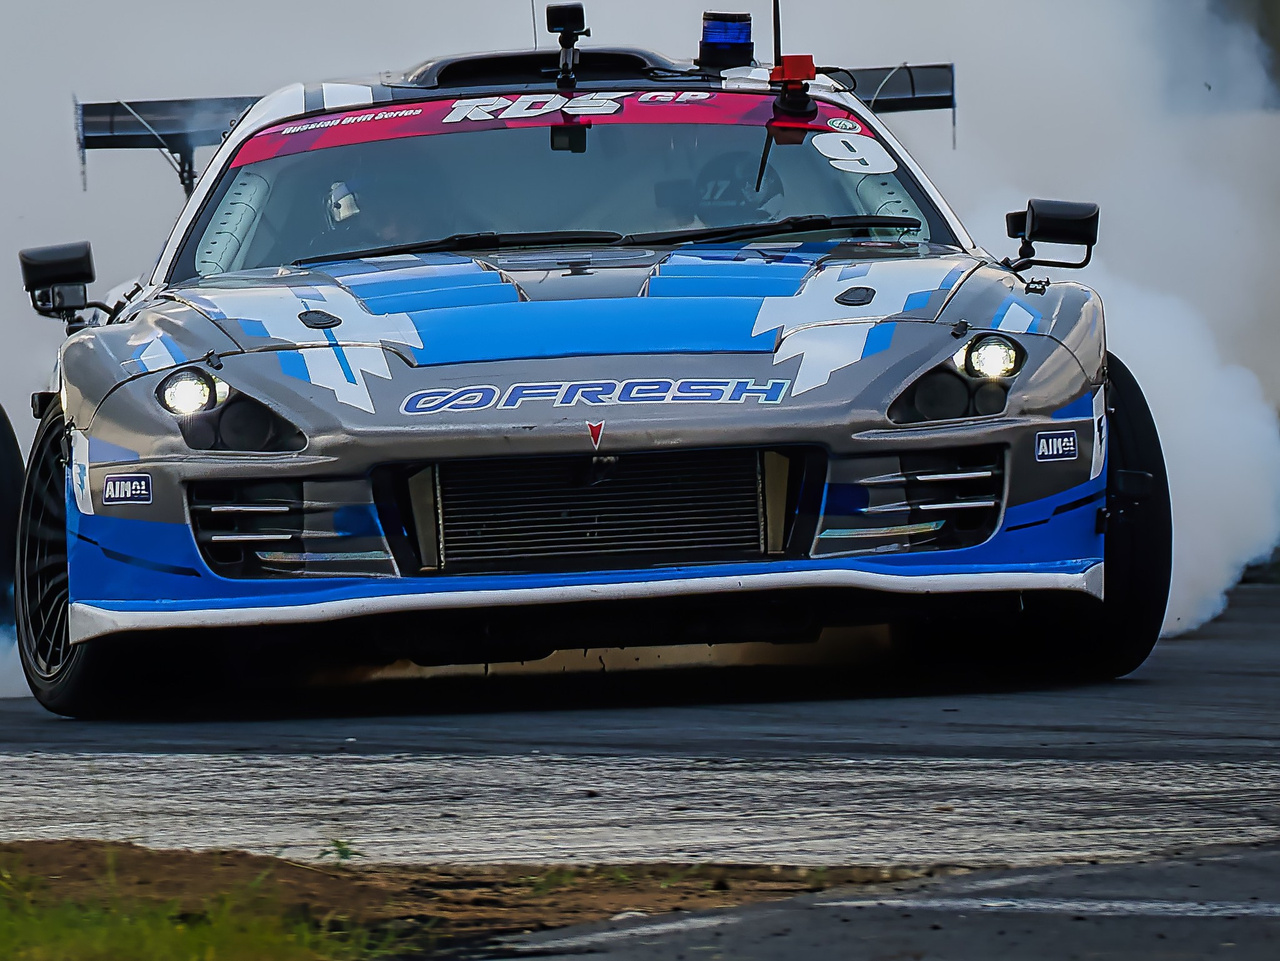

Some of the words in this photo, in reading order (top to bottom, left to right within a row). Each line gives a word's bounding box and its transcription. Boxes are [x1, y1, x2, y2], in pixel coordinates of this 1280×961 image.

[442, 92, 634, 123] RDS
[637, 92, 710, 103] GP
[811, 132, 898, 174] 9
